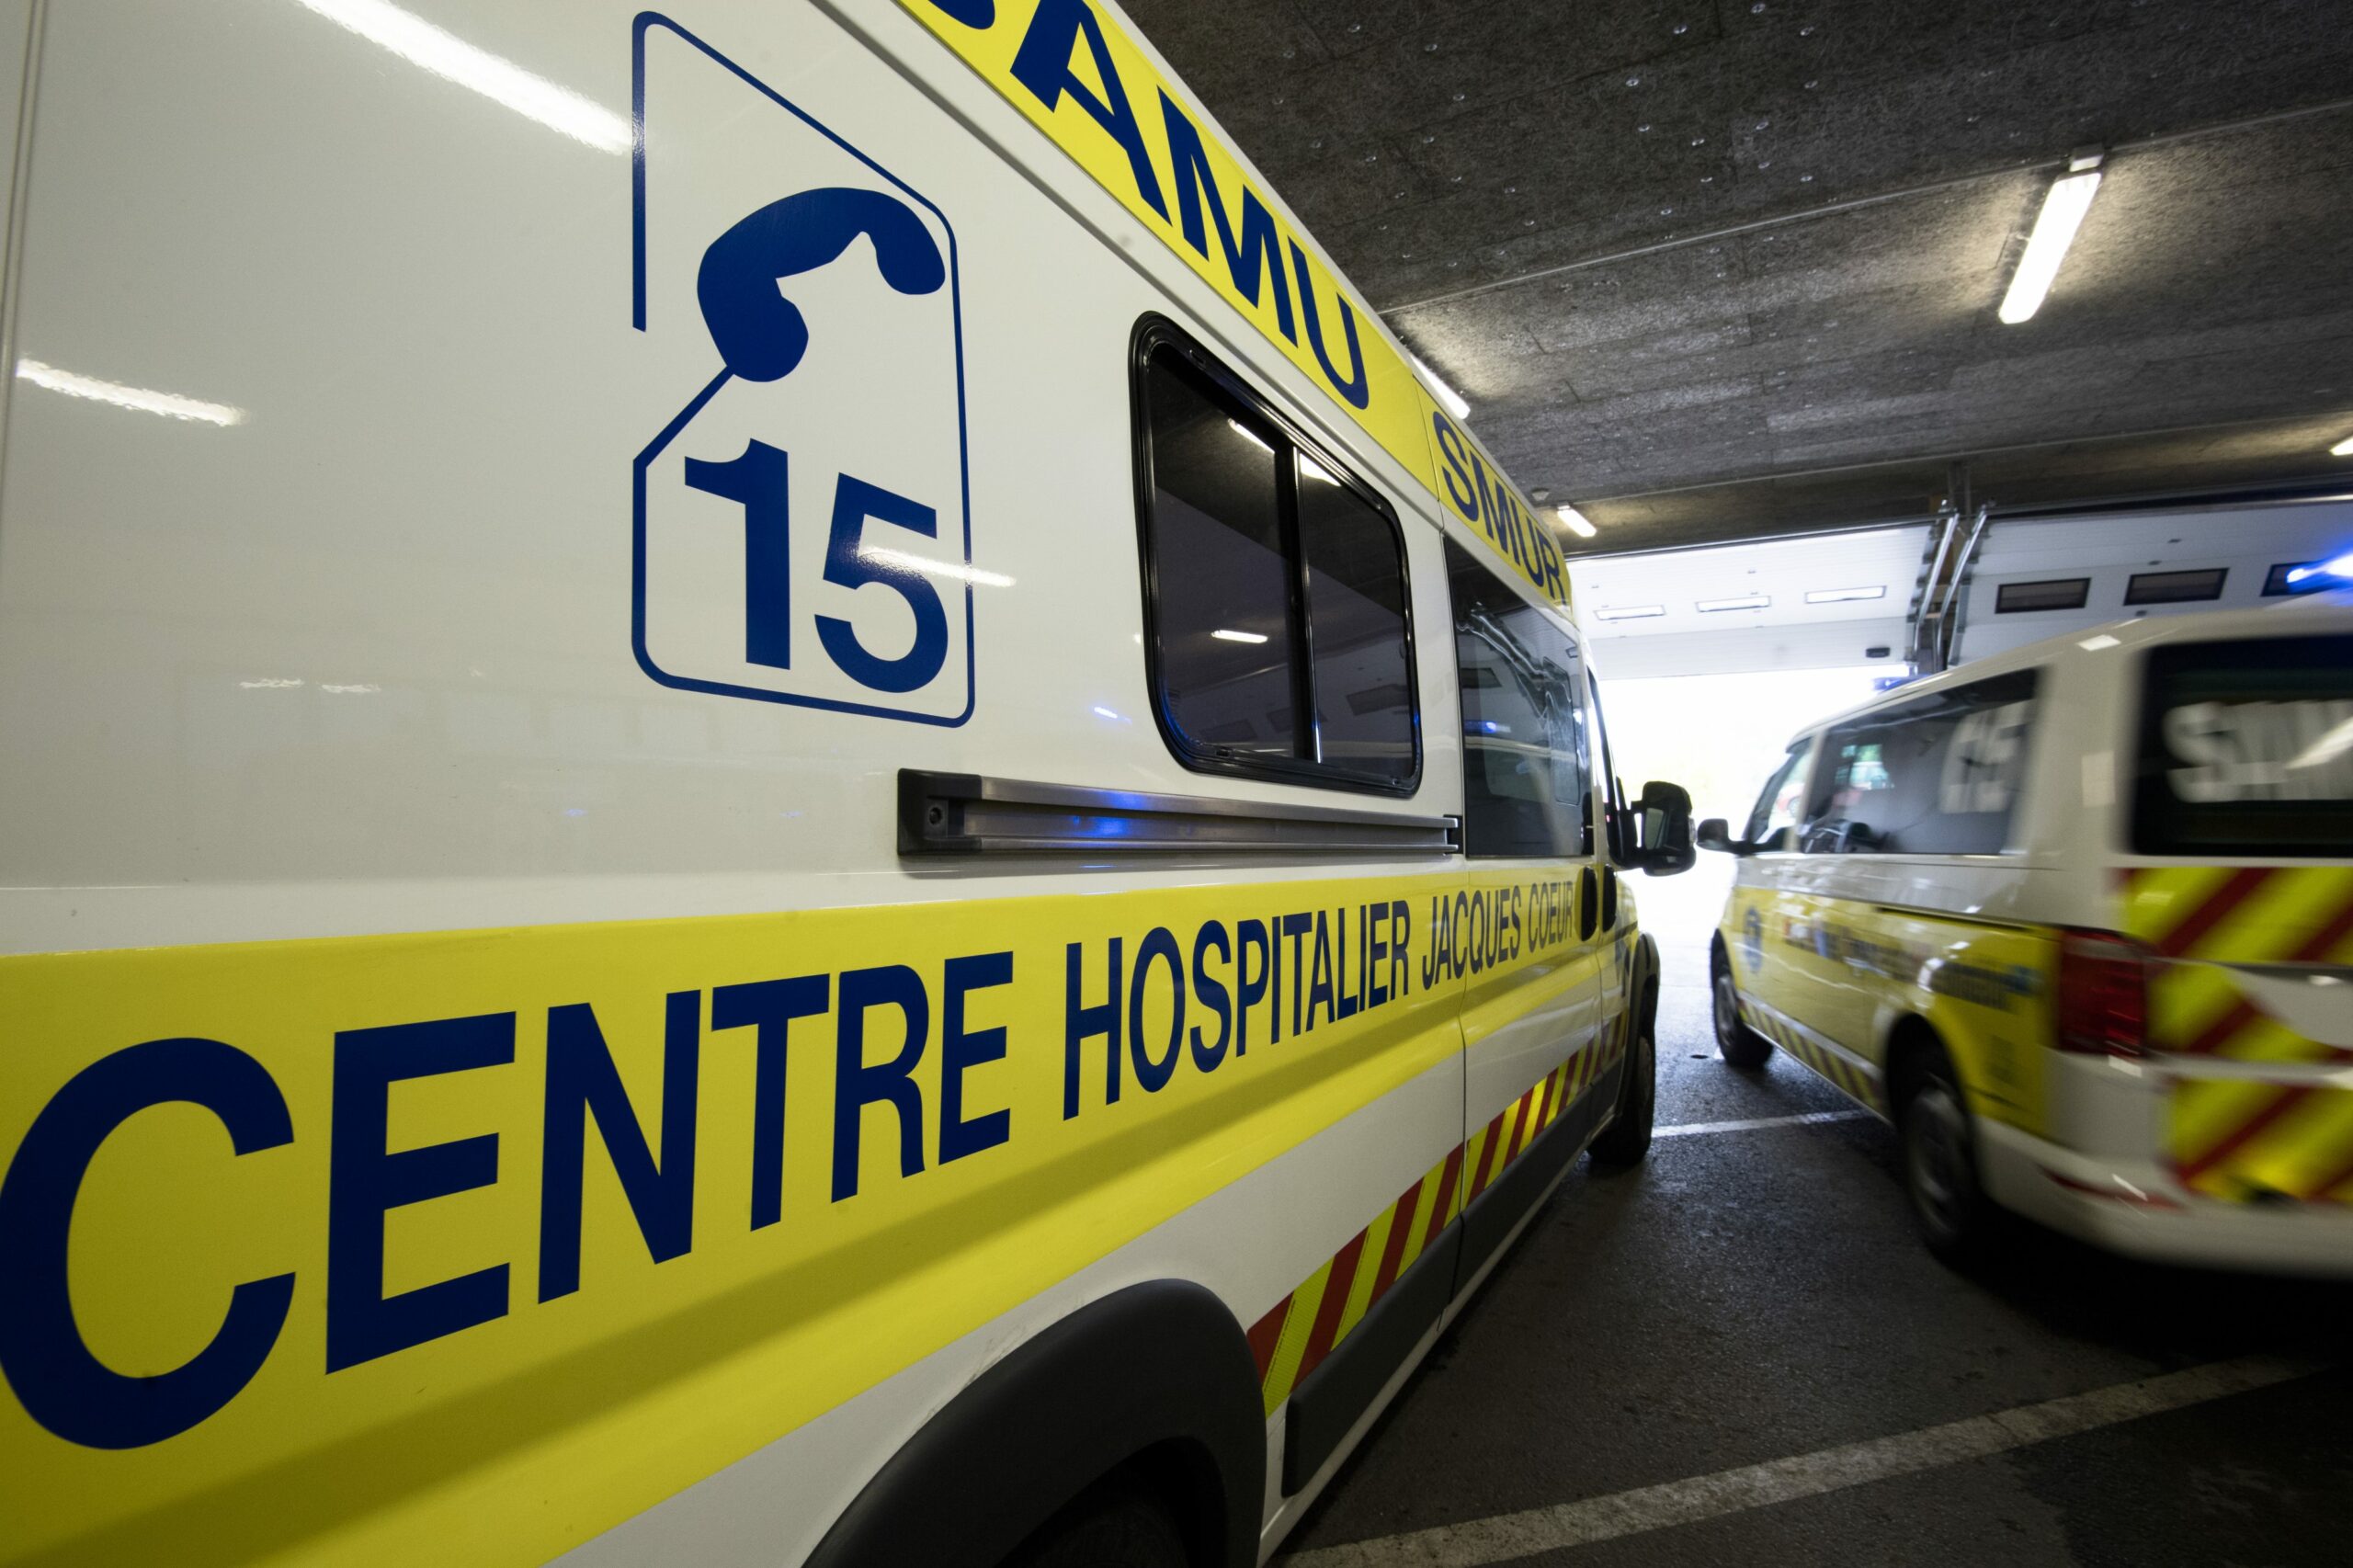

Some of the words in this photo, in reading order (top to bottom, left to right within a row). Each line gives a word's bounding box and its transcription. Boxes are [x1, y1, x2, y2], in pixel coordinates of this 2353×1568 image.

[926, 0, 1369, 410] AMU
[685, 437, 949, 694] 15
[1433, 411, 1566, 605] SMUR
[0, 951, 1014, 1450] CENTRE
[1063, 900, 1411, 1120] HOSPITALIER
[1422, 885, 1522, 991] JACQUES
[1528, 881, 1574, 953] COEUR
